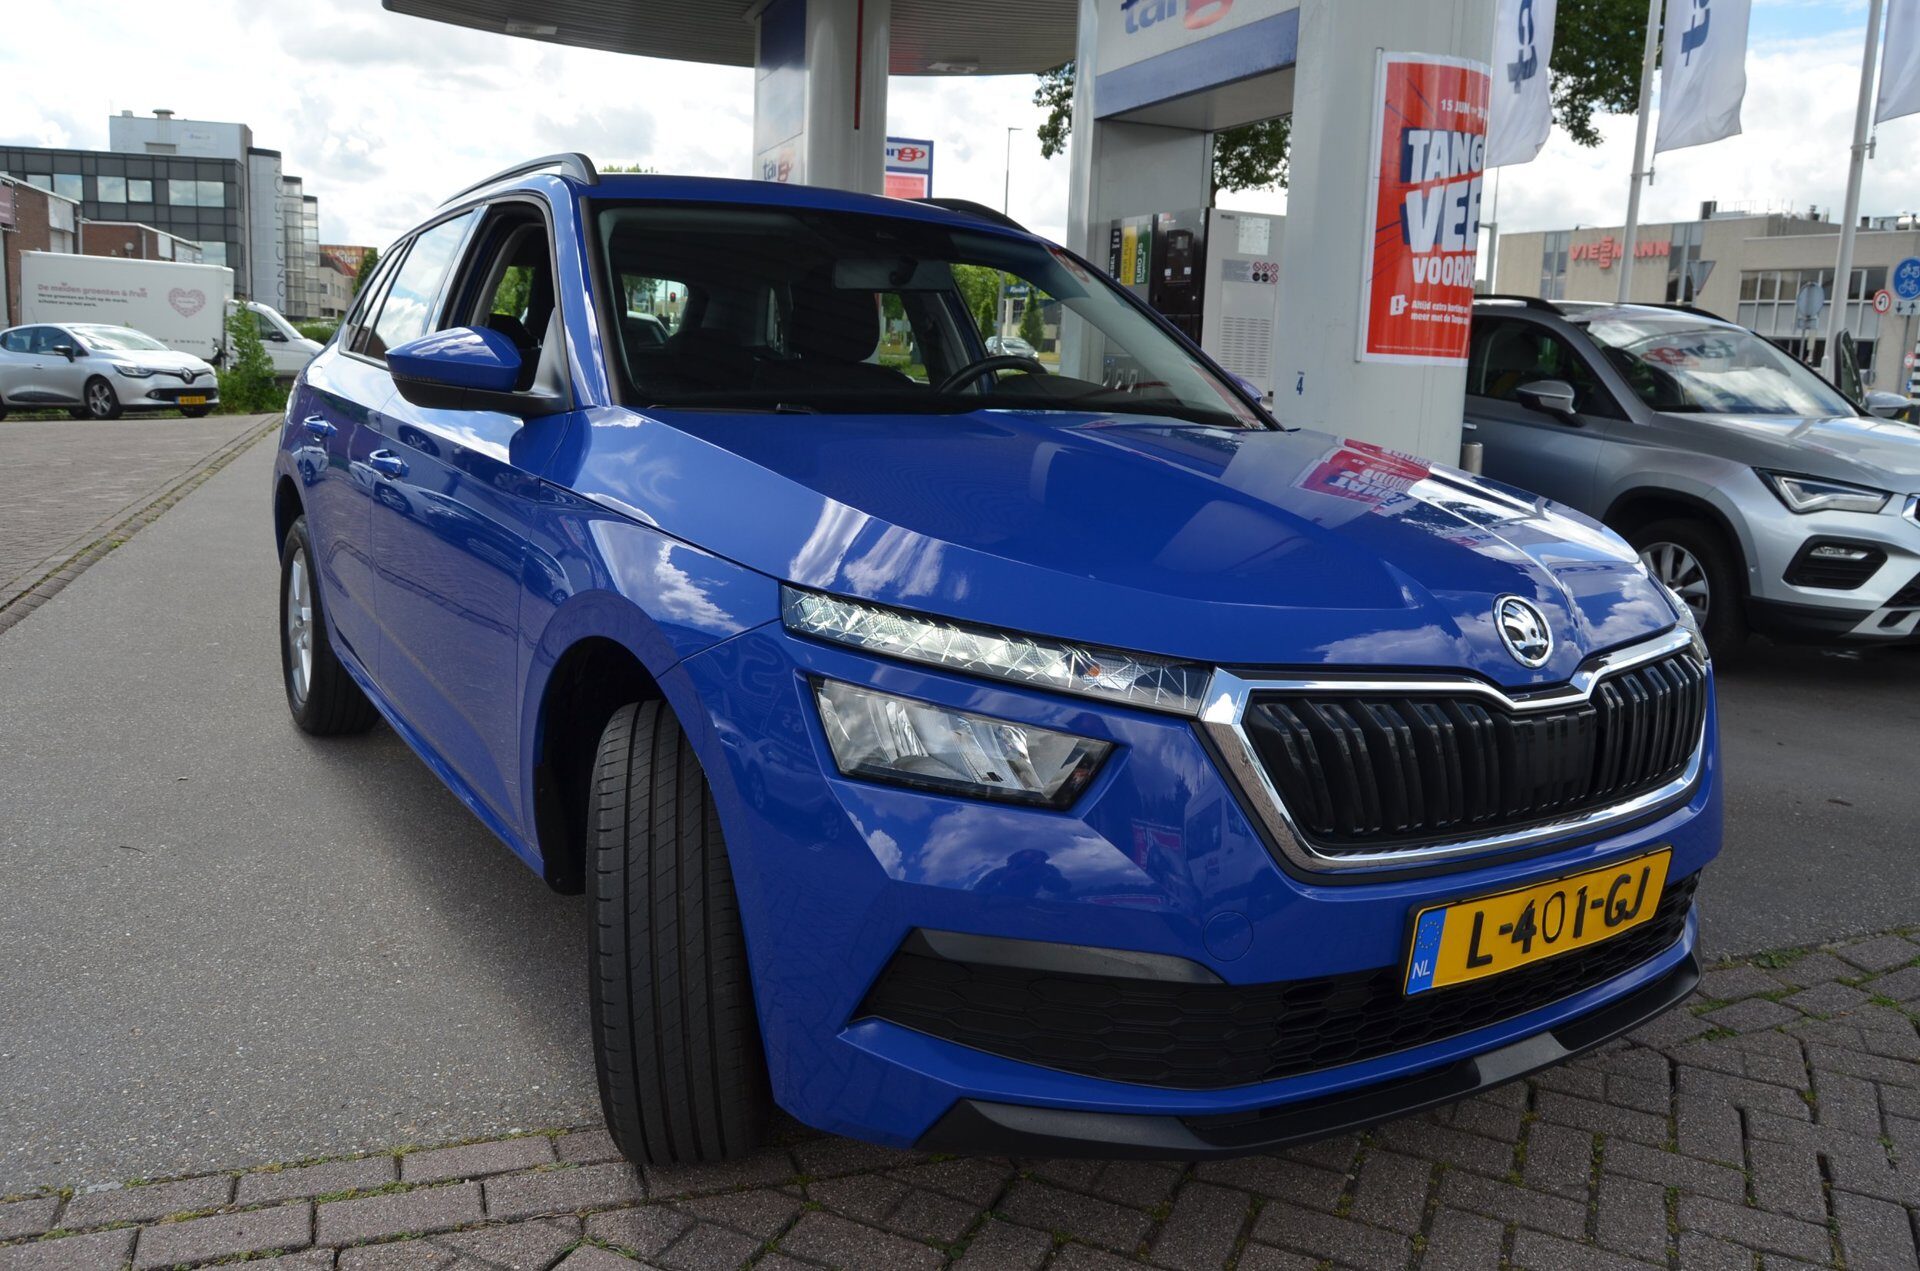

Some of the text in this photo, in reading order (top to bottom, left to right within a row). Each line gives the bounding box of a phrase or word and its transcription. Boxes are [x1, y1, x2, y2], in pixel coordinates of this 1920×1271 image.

[1408, 130, 1484, 184] TANG
[1296, 376, 1304, 395] 4
[1466, 866, 1651, 969] L-401-GJ
[1411, 958, 1431, 980] NL
